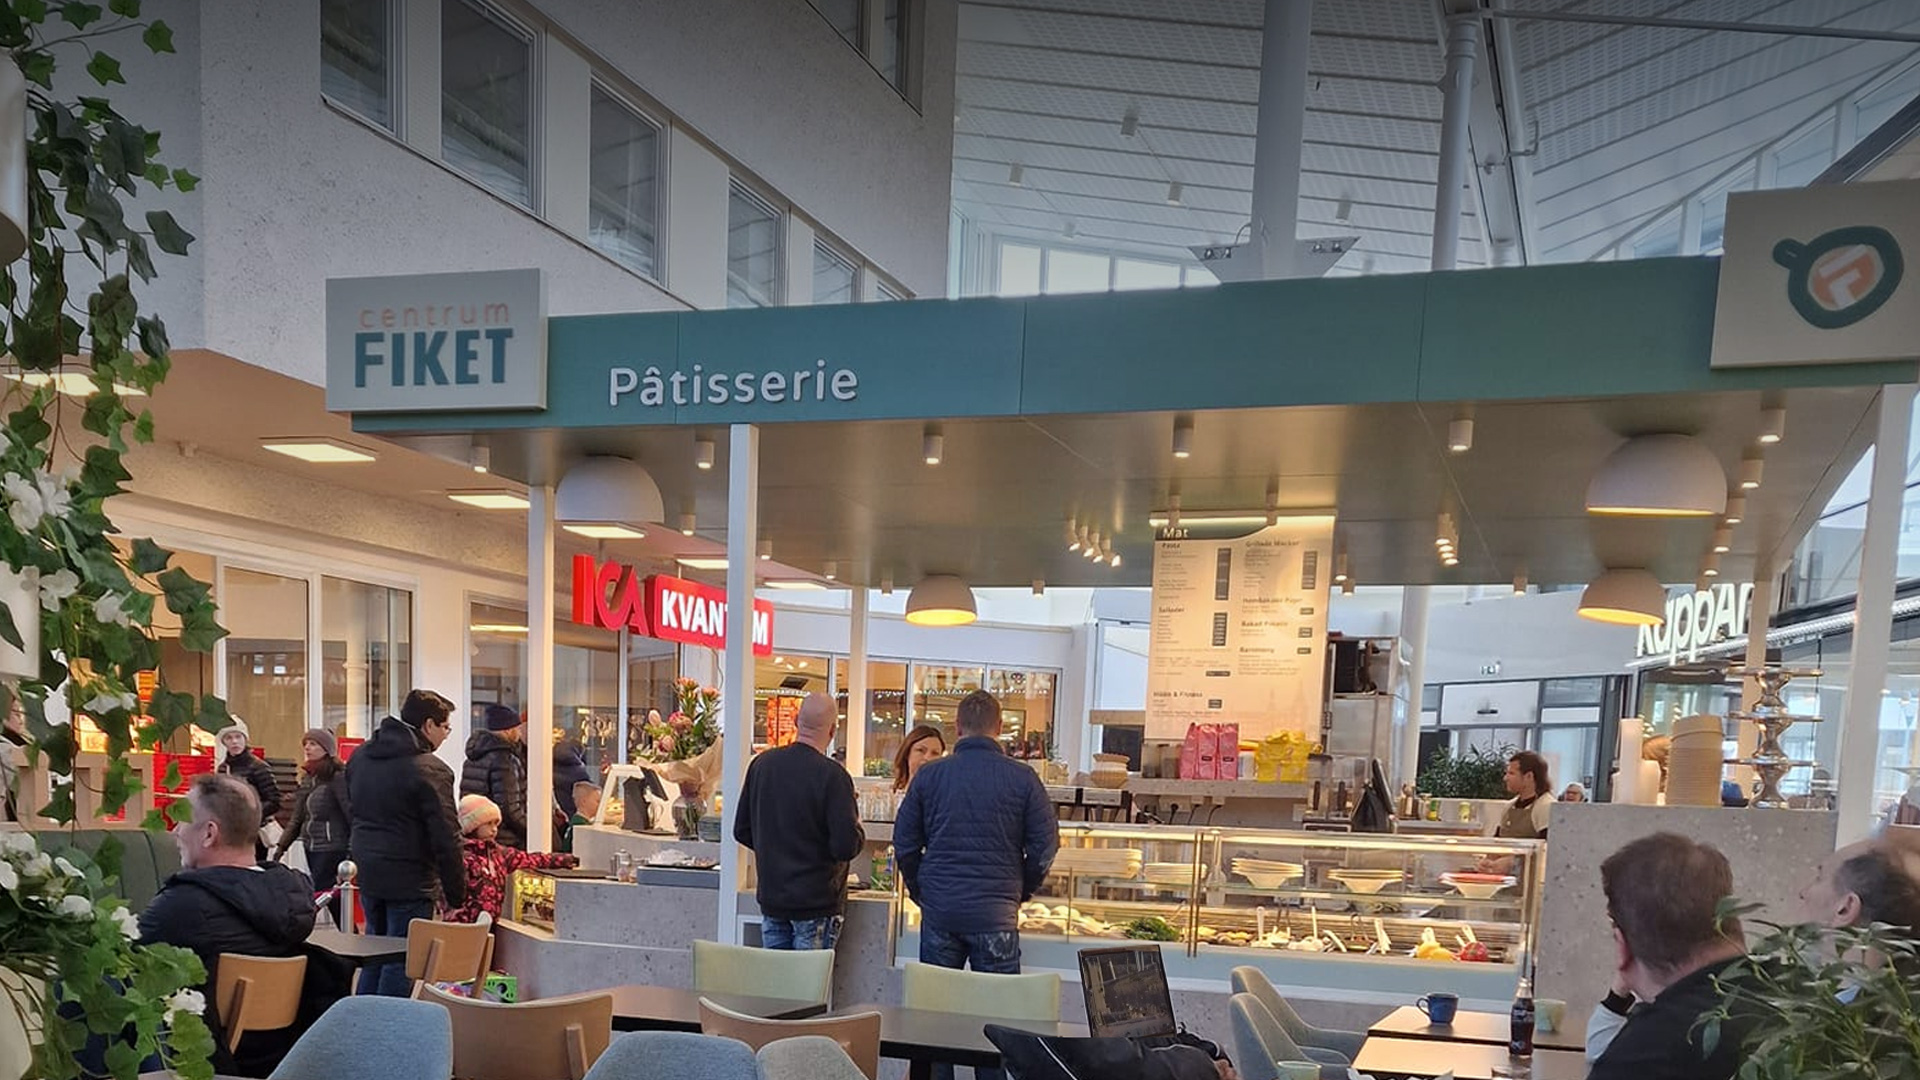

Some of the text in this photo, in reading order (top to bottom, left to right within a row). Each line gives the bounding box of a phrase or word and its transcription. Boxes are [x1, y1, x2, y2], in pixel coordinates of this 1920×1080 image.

[358, 302, 509, 329] centrum
[354, 327, 514, 388] FIKET
[609, 358, 859, 407] Pâtisserie
[1163, 527, 1189, 538] Mat
[573, 553, 650, 637] ICA
[661, 588, 769, 647] KVANM
